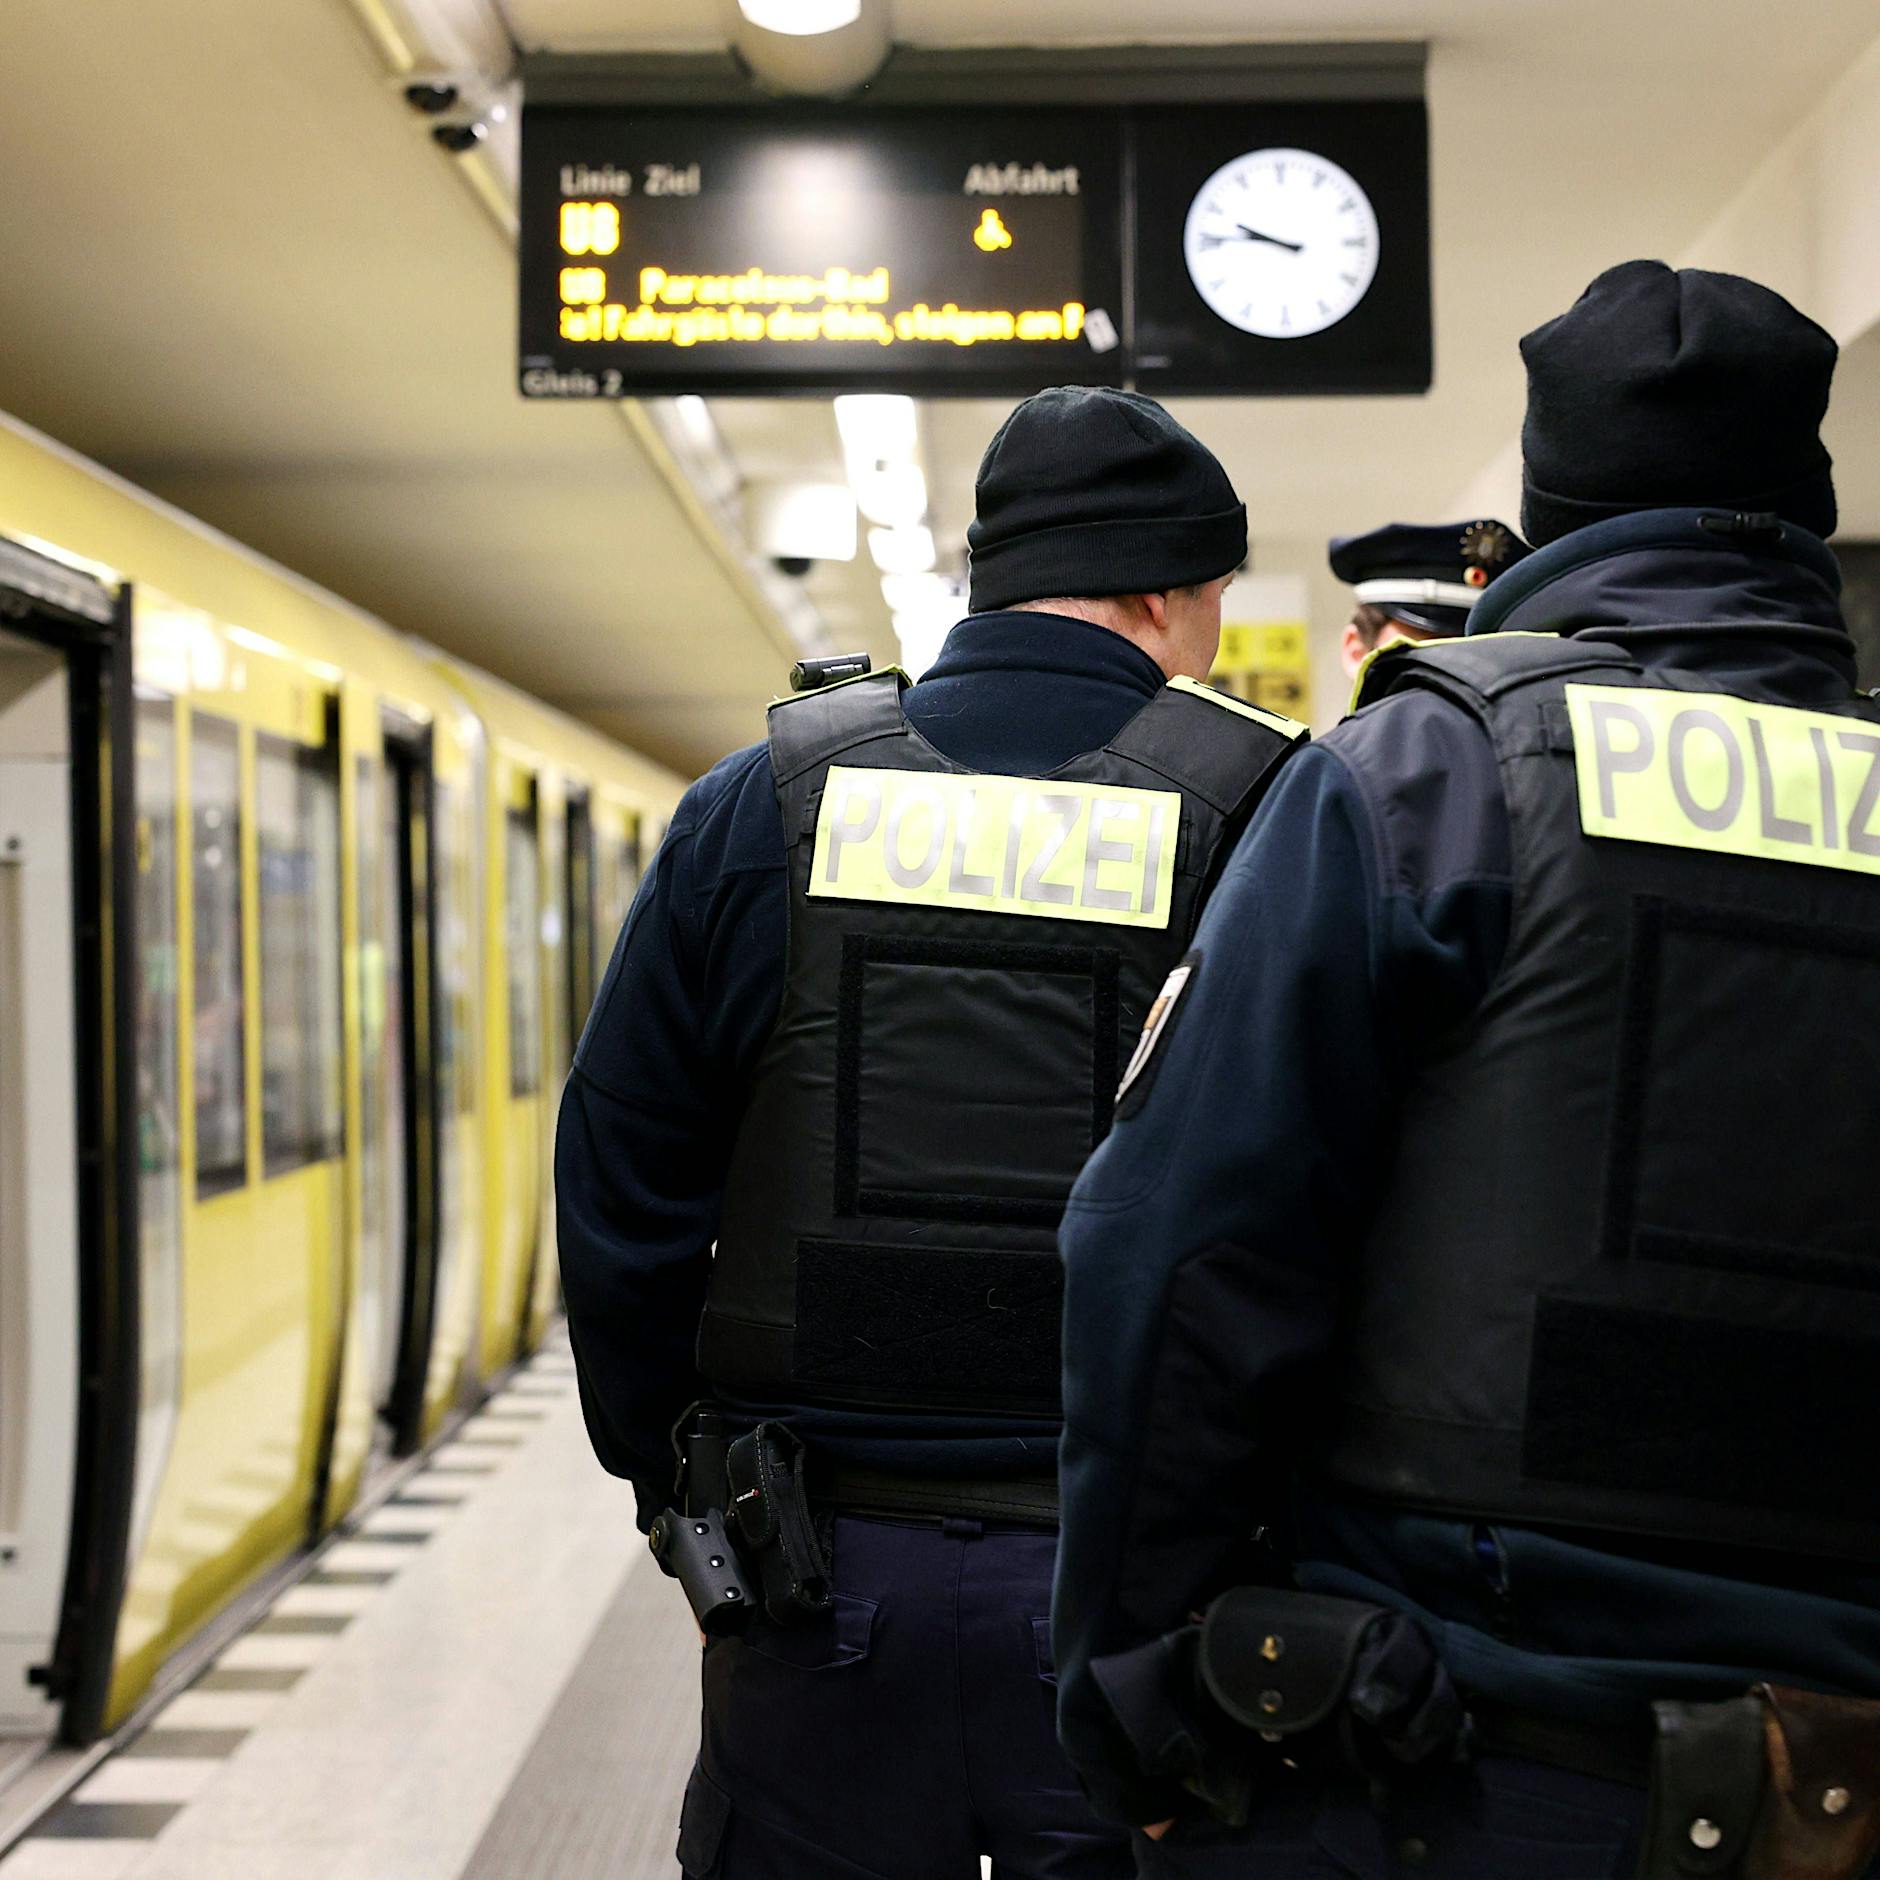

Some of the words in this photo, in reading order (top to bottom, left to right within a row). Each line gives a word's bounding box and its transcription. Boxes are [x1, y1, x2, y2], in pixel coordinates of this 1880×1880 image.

[561, 163, 632, 197] Linie
[643, 162, 701, 197] Ziel
[963, 161, 1080, 196] Abfahrt
[601, 367, 623, 397] 2
[825, 777, 1166, 914] POLIZEI
